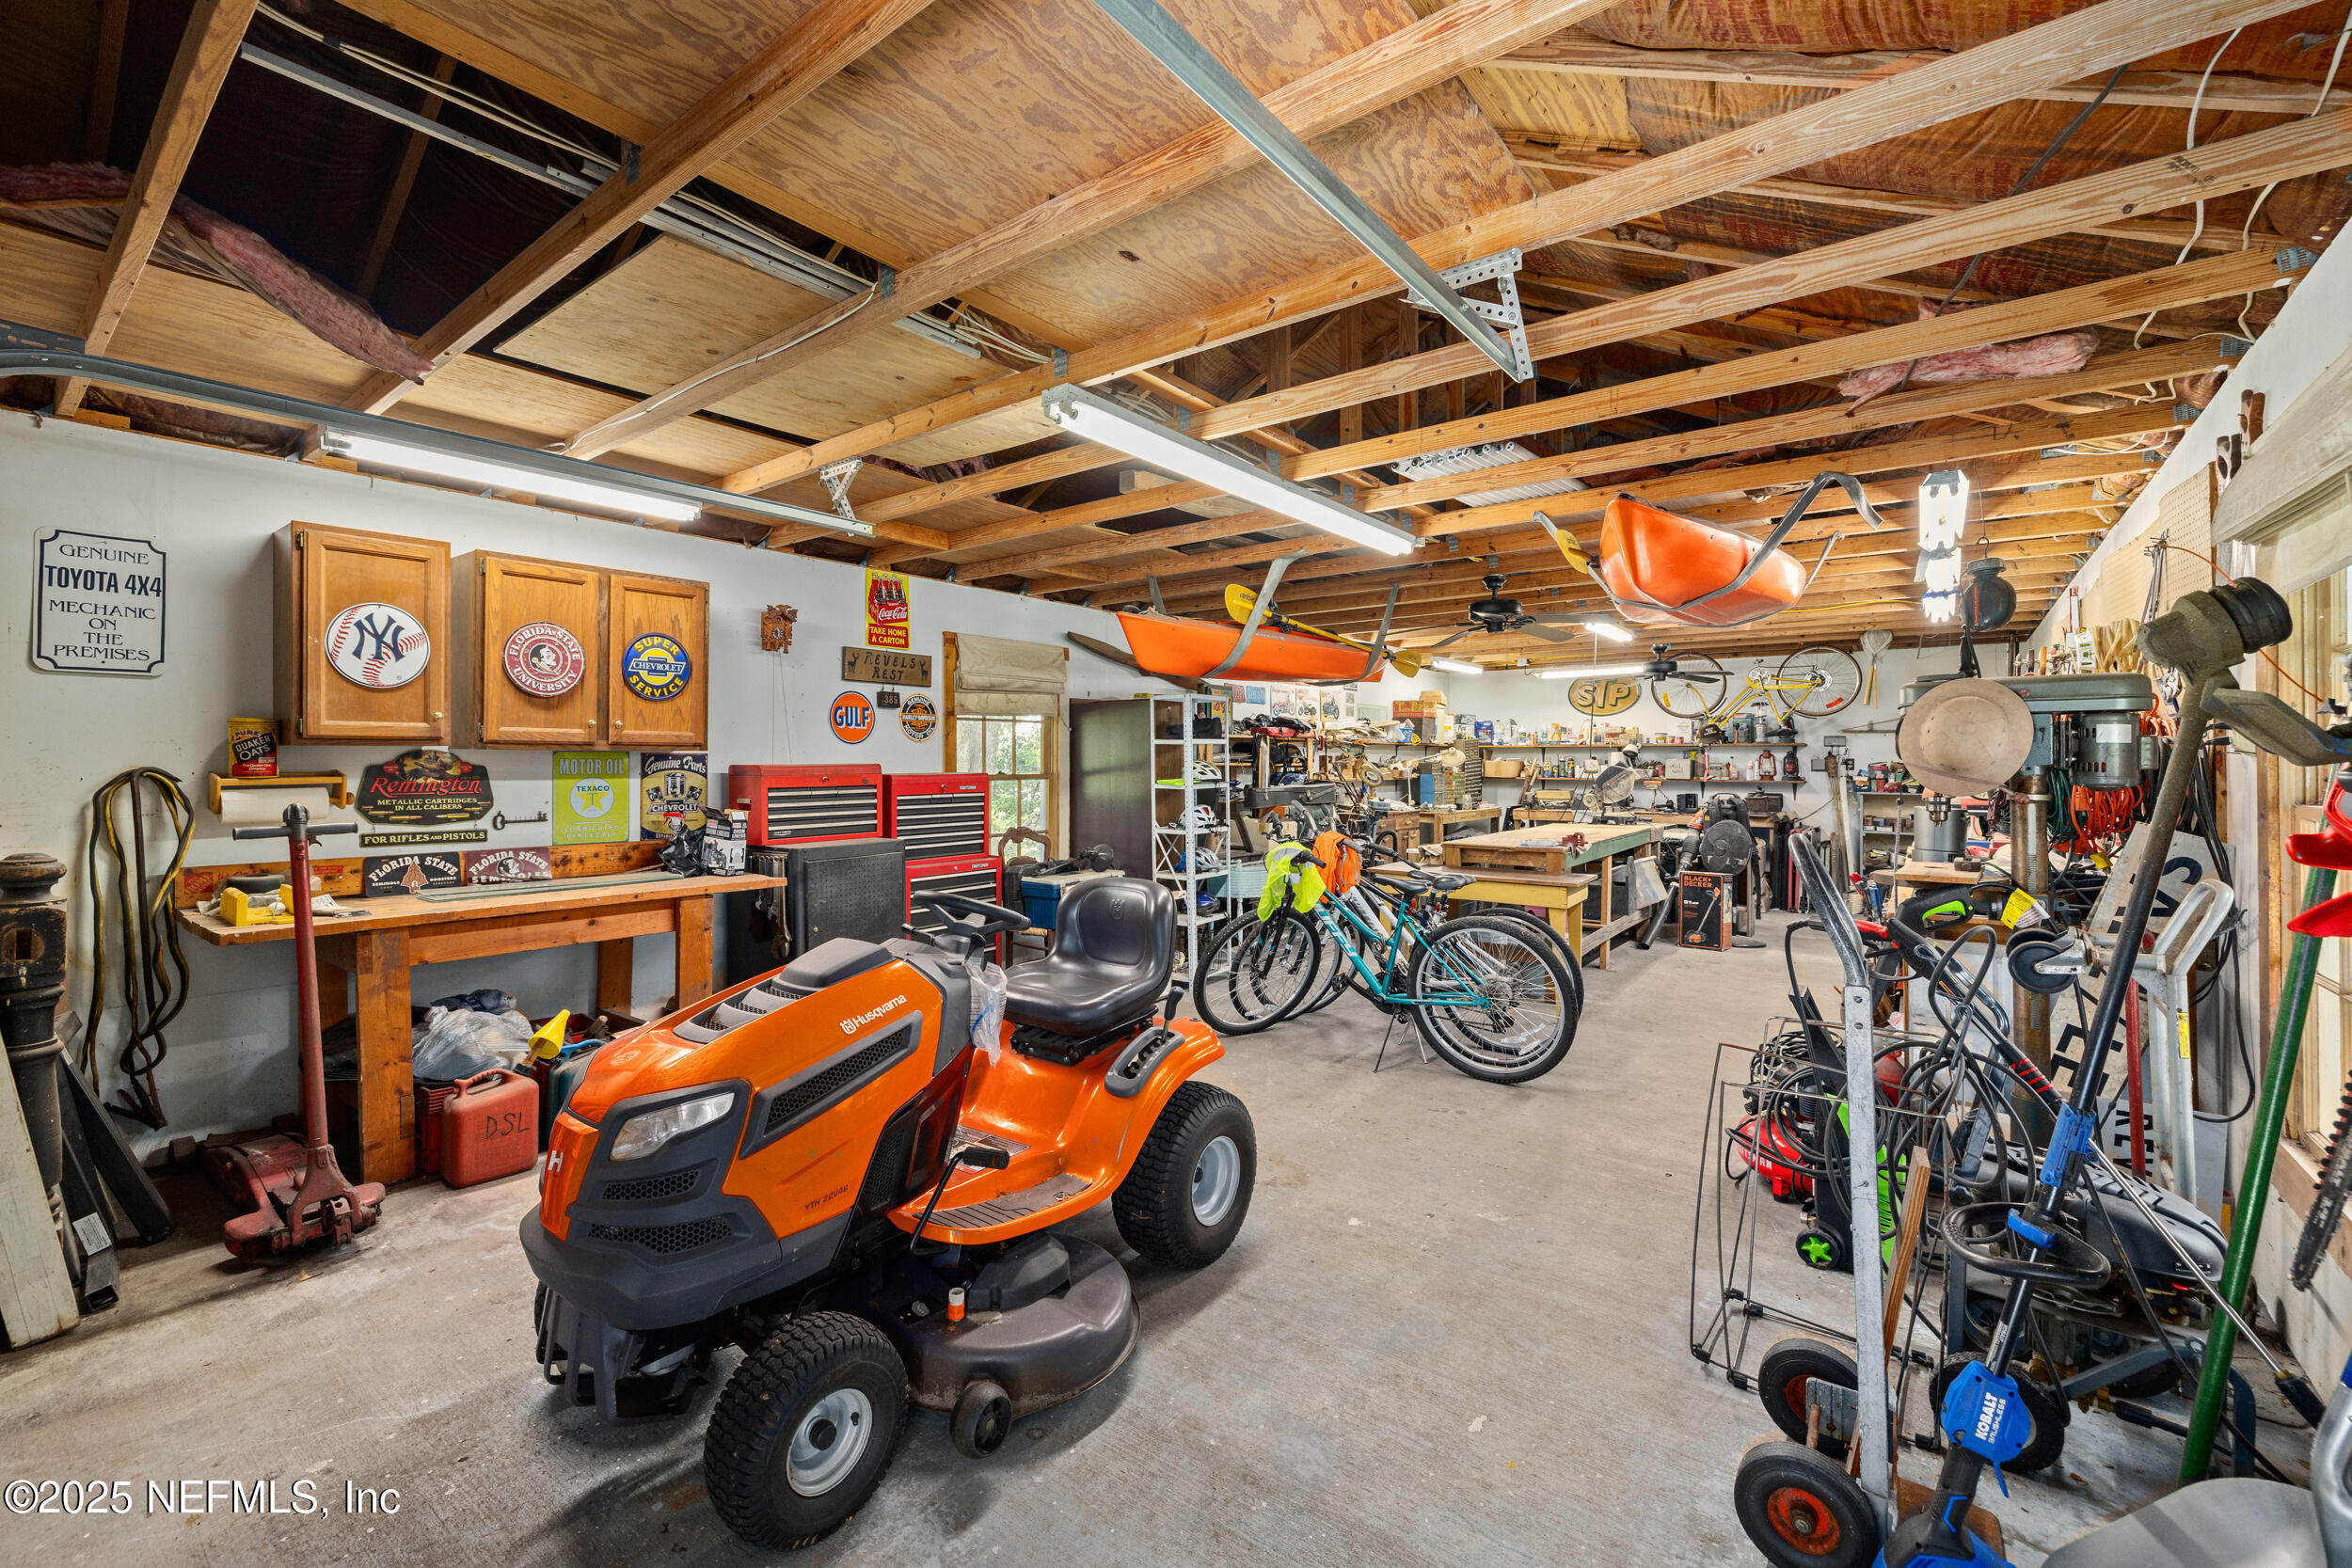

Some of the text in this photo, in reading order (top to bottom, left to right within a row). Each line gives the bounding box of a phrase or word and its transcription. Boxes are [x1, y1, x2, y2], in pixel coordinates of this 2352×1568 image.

[59, 544, 149, 564] GENUINE
[44, 564, 162, 597] TOYOTA 4X4
[49, 599, 156, 620] MECHANIC
[88, 618, 117, 630] ON
[870, 626, 907, 637] TAKE HOME
[83, 631, 123, 646] THE
[352, 612, 405, 662] NY
[509, 626, 580, 660] FLORIDA STATE
[879, 636, 905, 645] CARTON
[53, 644, 150, 661] PREMISES
[633, 637, 680, 656] SUPER
[632, 660, 683, 673] CHEVROLET
[864, 651, 916, 669] REVELS
[513, 668, 577, 691] UNIVERSITY
[872, 666, 904, 682] REST
[628, 674, 684, 697] SERVICE
[1578, 679, 1630, 708] STP
[907, 696, 930, 705] GENUINE
[834, 705, 871, 729] GULF
[233, 730, 262, 742] PURE
[904, 725, 924, 738] MOTOR
[235, 736, 271, 752] QUAKER
[240, 744, 271, 760] OATS
[559, 757, 625, 775] MOTOR OIL
[645, 755, 706, 774] Genuine Parts
[369, 776, 483, 799] Remington
[652, 803, 698, 812] CHEVROLET
[564, 824, 620, 833] LUBRICATES
[364, 836, 388, 845] FOR
[389, 834, 430, 843] RIFLES
[442, 832, 485, 841] PISTOLS
[368, 856, 459, 882] FLORIDA STATE
[469, 850, 548, 876] FLORIDA STATE
[851, 994, 907, 1027] Husqvarna
[485, 1112, 530, 1140] DSL
[1975, 1392, 1997, 1441] KOBALT
